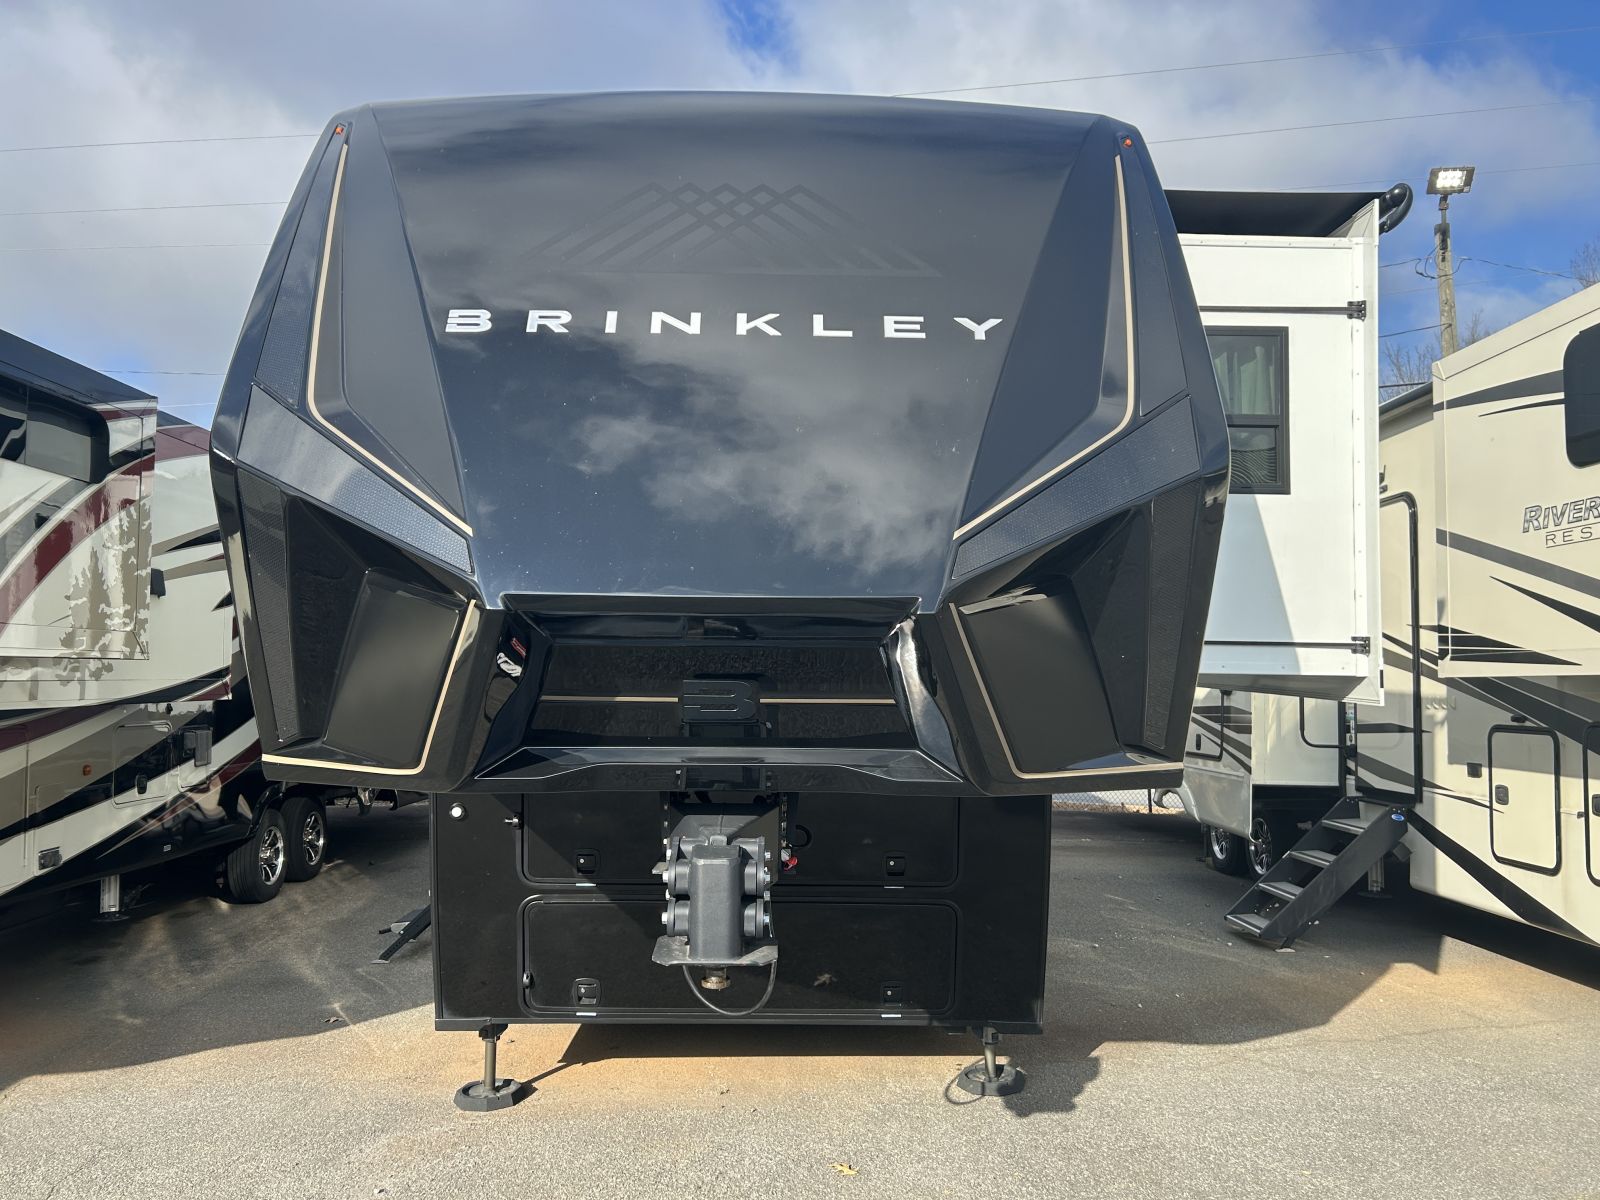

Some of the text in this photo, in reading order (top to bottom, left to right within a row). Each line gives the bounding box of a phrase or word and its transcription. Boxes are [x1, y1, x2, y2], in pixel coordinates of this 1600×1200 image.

[445, 309, 1003, 340] BRINKLEY
[1522, 496, 1600, 533] RIVER
[1545, 526, 1593, 545] RES
